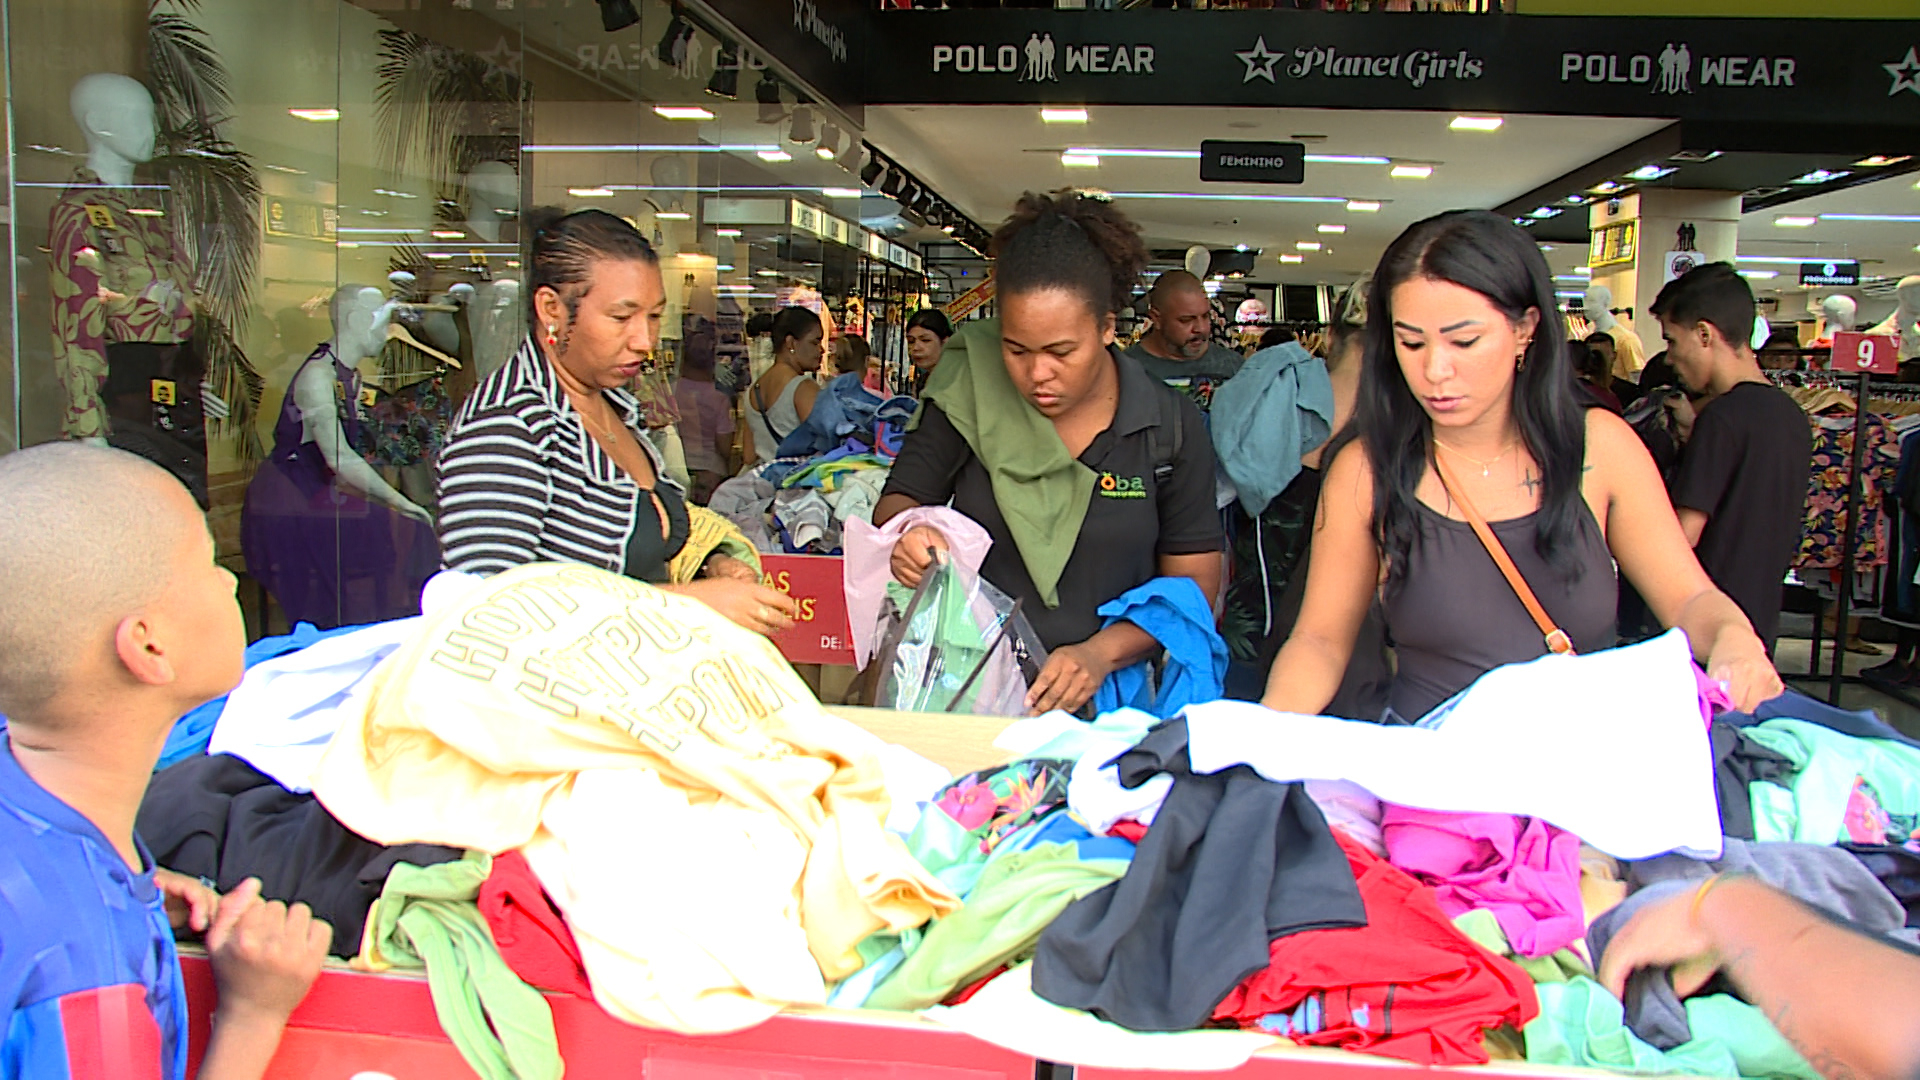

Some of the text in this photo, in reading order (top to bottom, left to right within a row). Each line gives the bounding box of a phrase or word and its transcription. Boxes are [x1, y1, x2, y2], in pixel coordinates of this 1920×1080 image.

[933, 45, 1155, 73] POLO WEAR
[1287, 46, 1484, 88] Planet Girls
[1561, 53, 1796, 87] POLO WEAR
[1219, 155, 1285, 169] FEMININO
